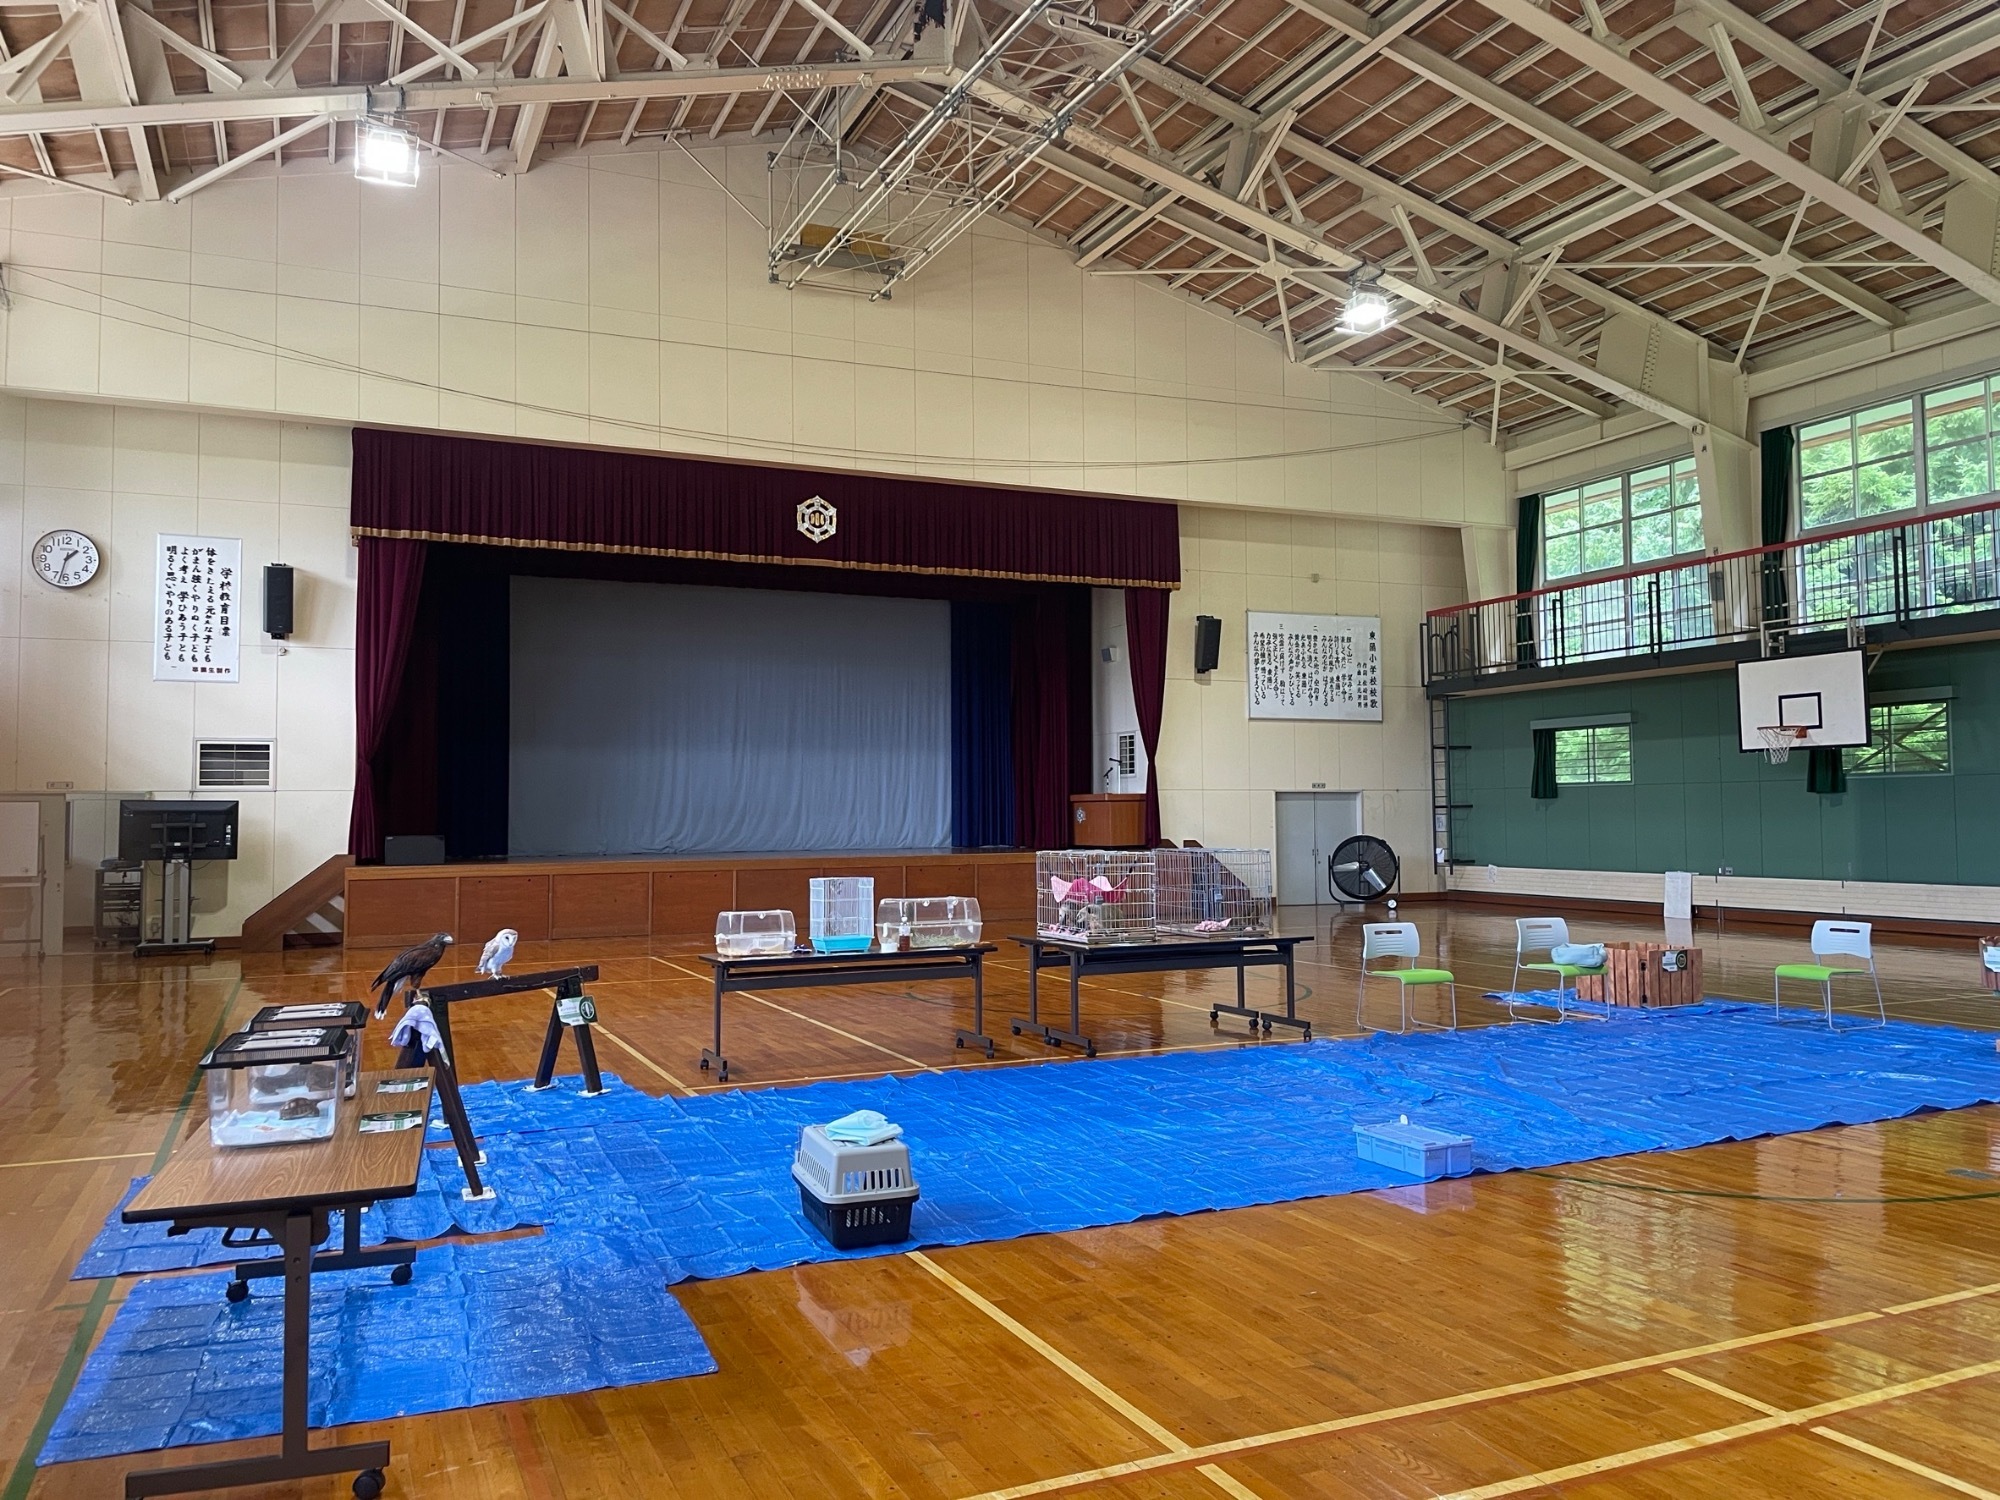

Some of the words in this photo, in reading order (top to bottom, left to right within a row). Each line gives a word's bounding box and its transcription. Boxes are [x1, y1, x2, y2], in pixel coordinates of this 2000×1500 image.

[51, 536, 60, 546] 11
[62, 536, 72, 545] 12
[41, 545, 53, 553] 10
[82, 546, 89, 554] 2
[39, 554, 47, 562] 9
[85, 556, 93, 564] 3
[43, 563, 51, 571] 8
[52, 571, 59, 579] 7
[62, 573, 70, 581] 6
[73, 572, 81, 580] 5
